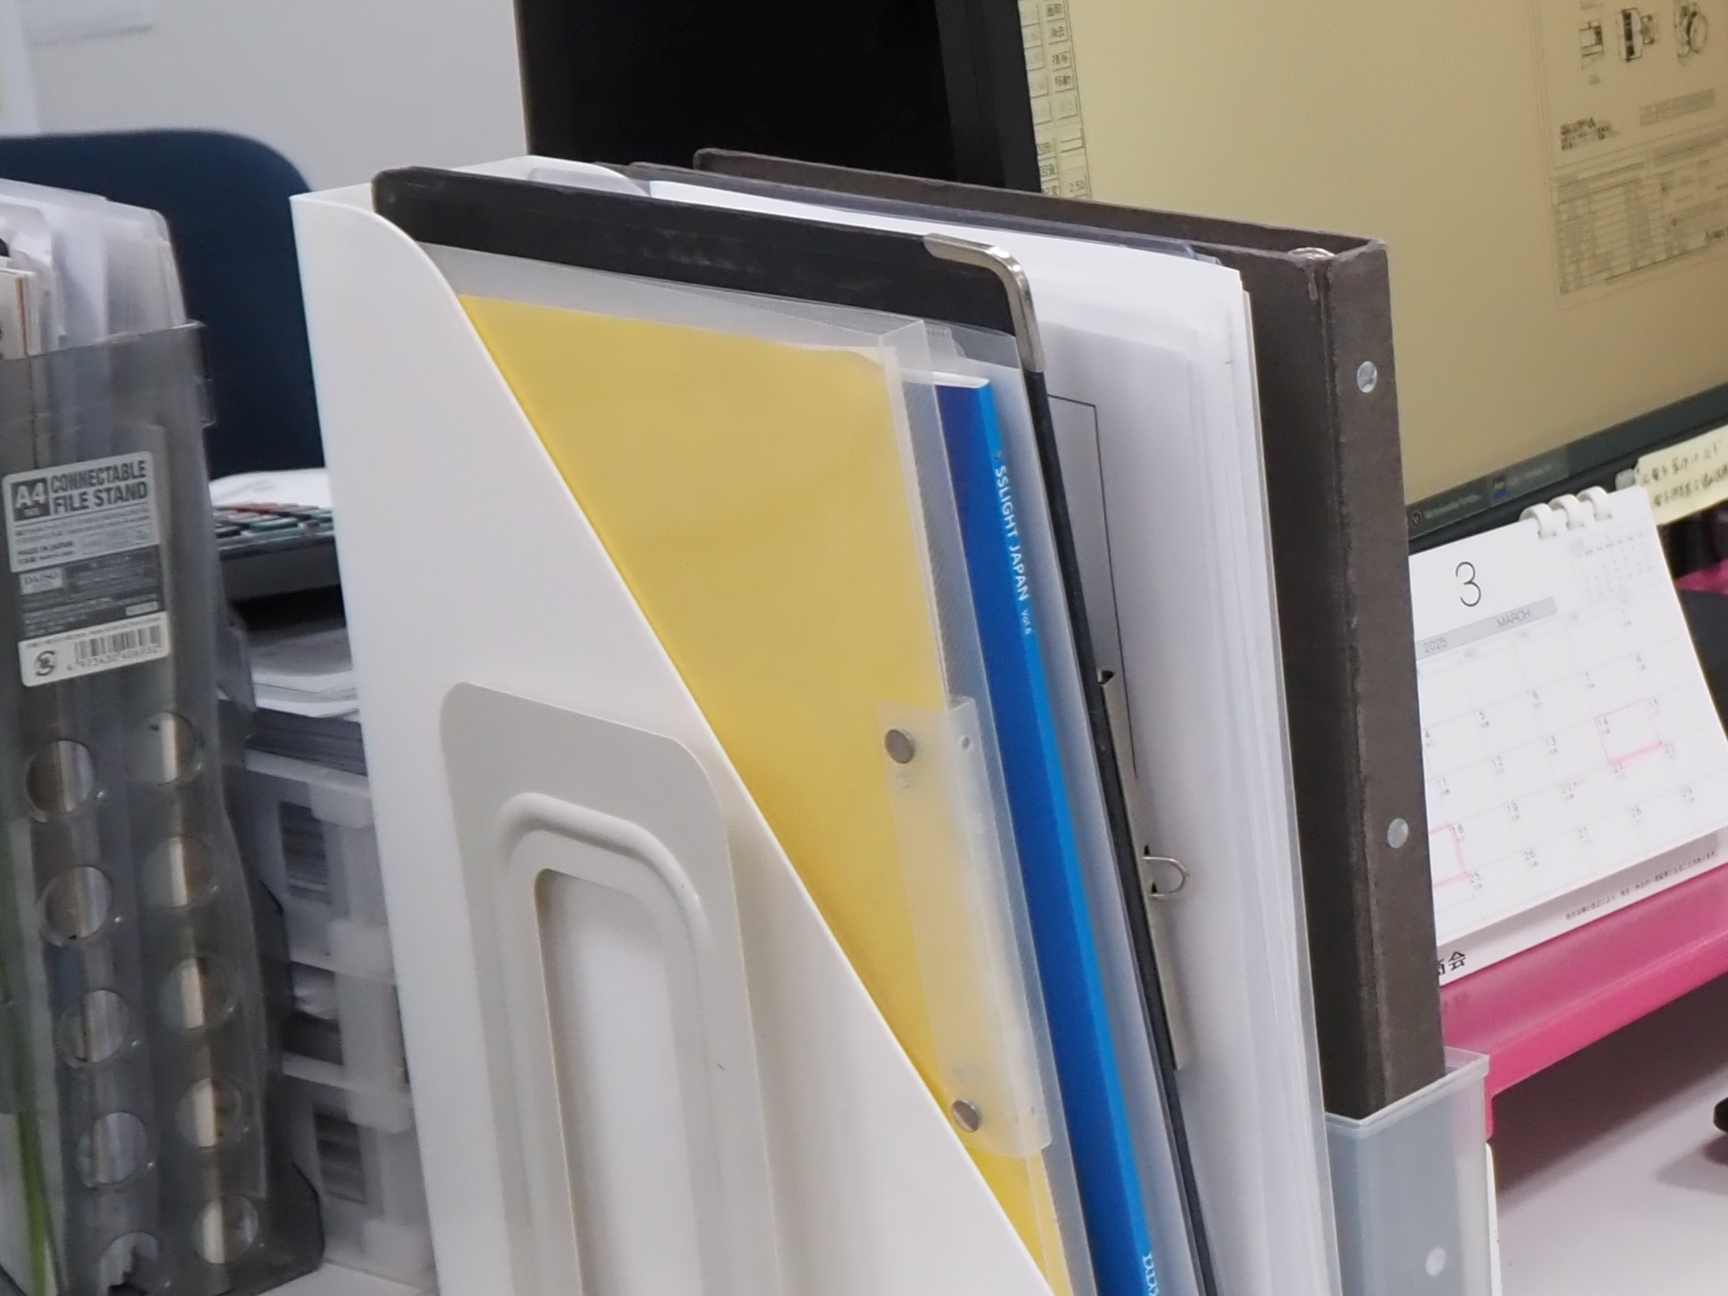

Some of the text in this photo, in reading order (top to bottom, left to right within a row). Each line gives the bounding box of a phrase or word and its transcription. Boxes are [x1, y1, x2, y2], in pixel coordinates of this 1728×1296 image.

[50, 460, 147, 494] CONNECTABLE
[15, 481, 47, 510] A4
[52, 481, 149, 516] FILE STAND
[1009, 544, 1031, 602] JAPAN
[1455, 560, 1482, 608] 3
[1496, 607, 1532, 628] MARCH
